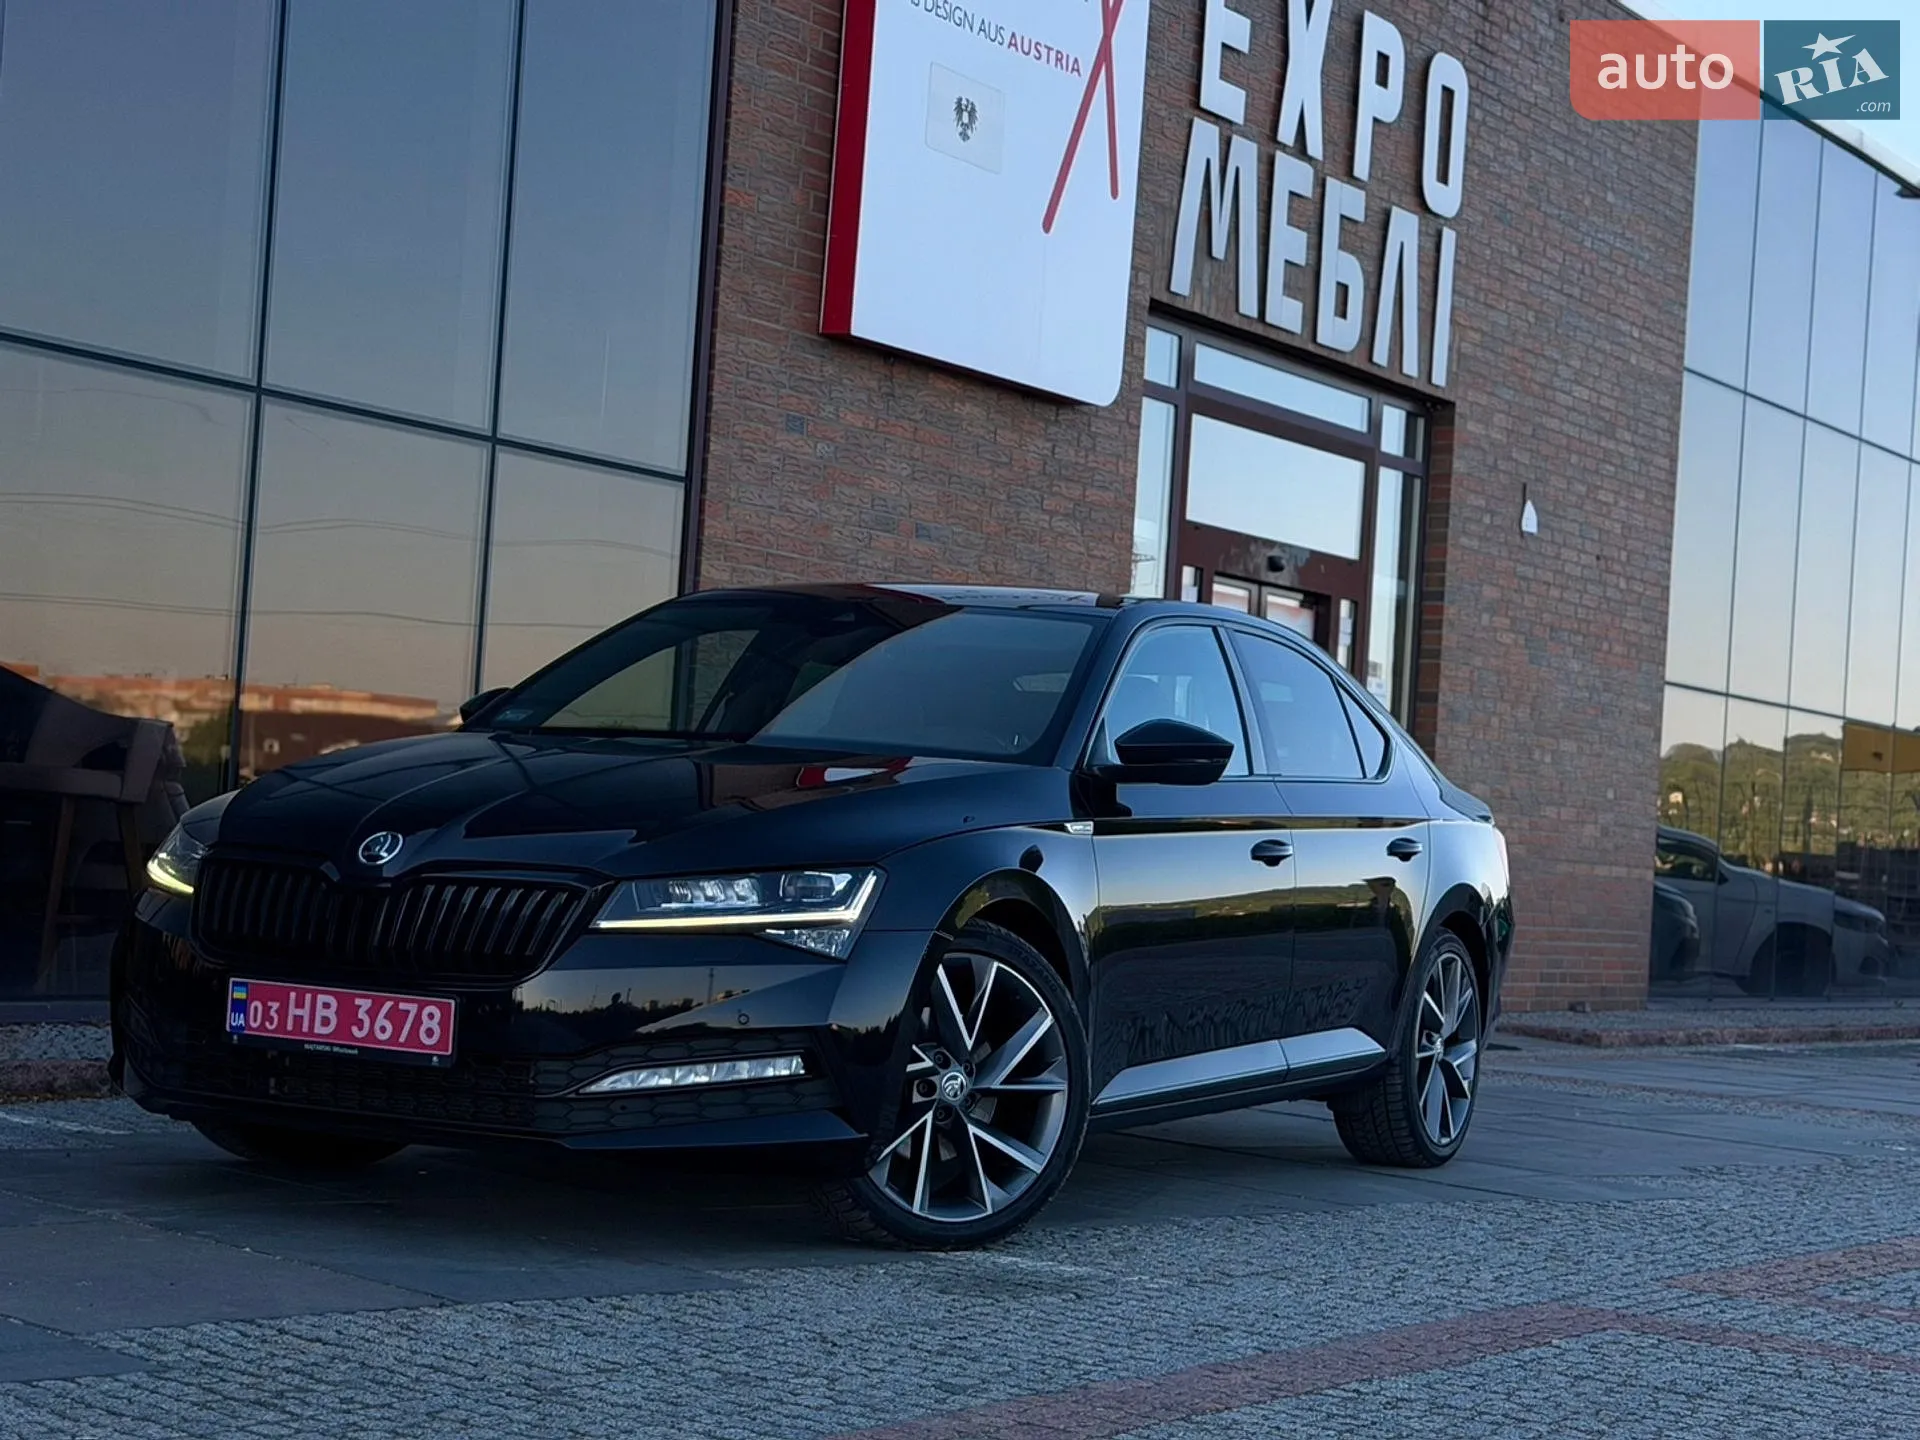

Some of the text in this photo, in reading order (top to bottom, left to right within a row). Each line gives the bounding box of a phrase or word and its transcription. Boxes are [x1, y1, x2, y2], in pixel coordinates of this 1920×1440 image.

[924, 0, 1082, 77] DESIGN AUS AUSTRIA
[1199, 0, 1469, 219] EXPO
[1169, 116, 1457, 388] МЕБЛІ
[231, 991, 442, 1046] UA 03 HB 3678
